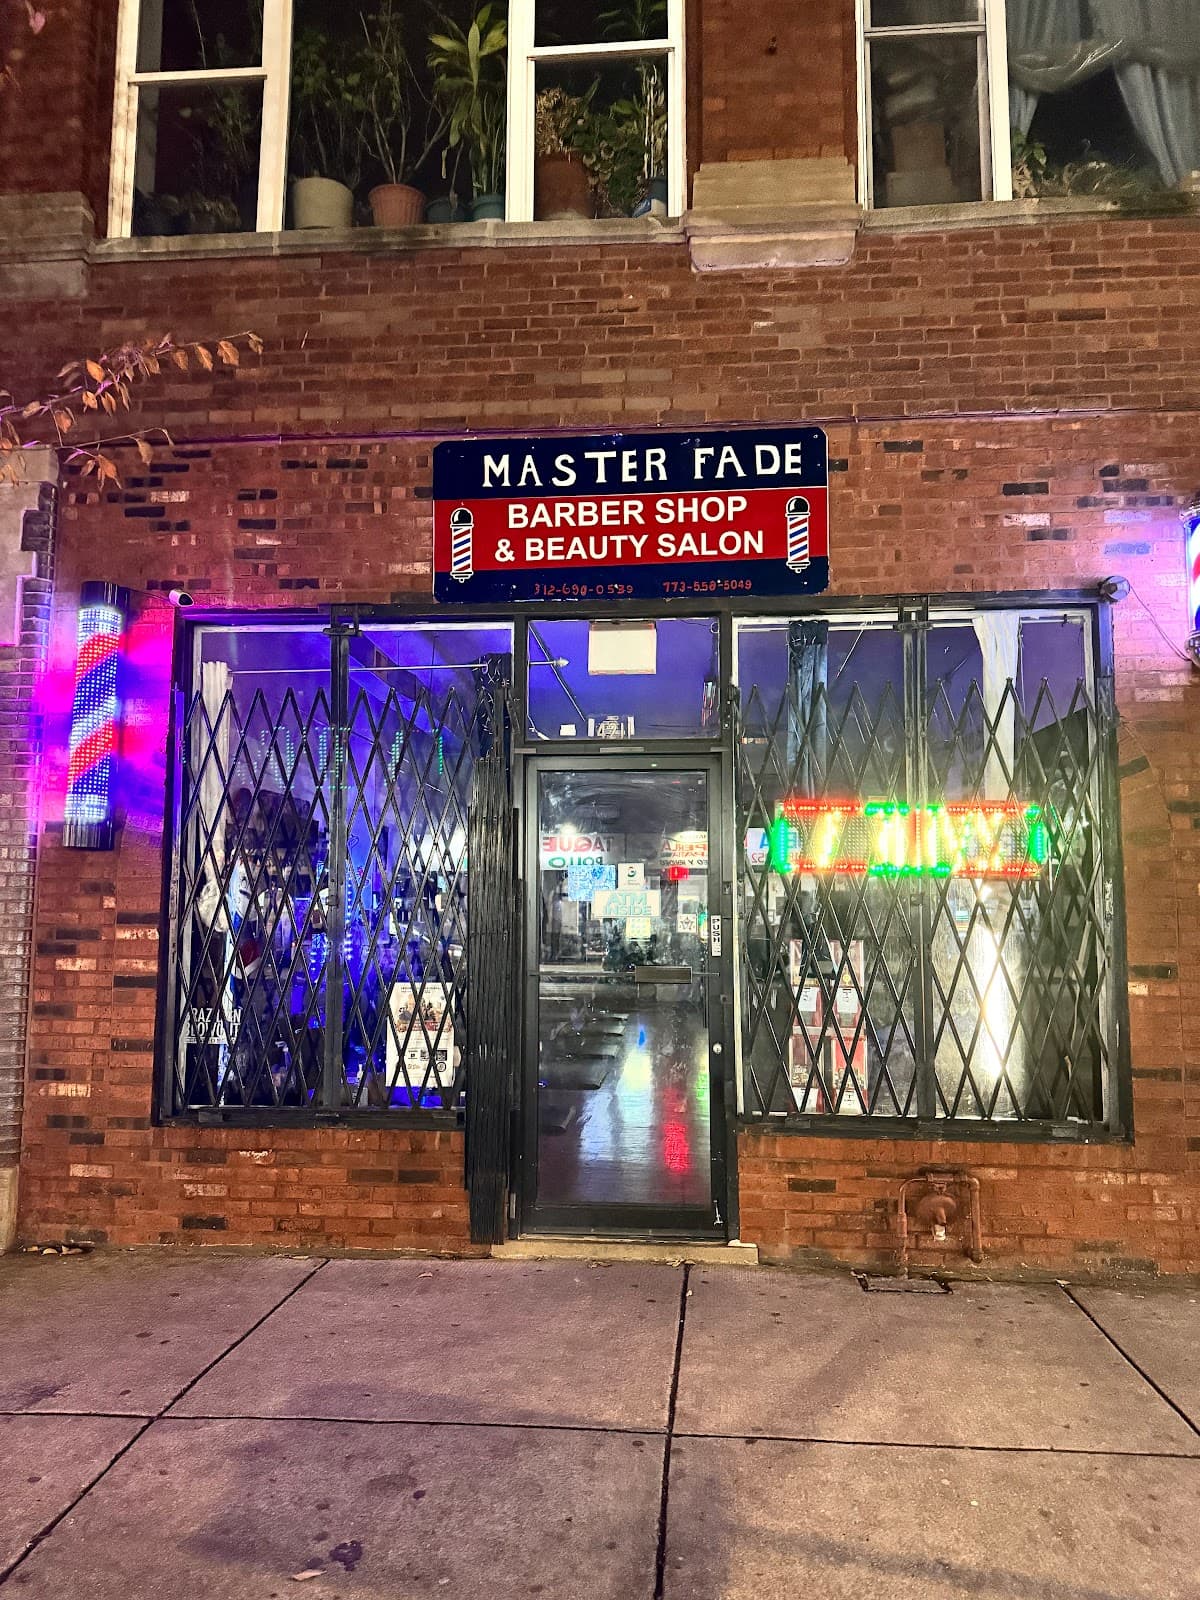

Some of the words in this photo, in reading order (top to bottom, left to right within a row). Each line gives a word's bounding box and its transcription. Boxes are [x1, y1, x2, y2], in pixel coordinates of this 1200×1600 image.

[482, 447, 667, 488] MASTER
[694, 443, 802, 480] FADE
[507, 500, 645, 529] BARBER
[655, 496, 747, 524] SHOP
[494, 540, 515, 562] &
[525, 534, 649, 561] BEAUTY
[657, 530, 764, 557] SALON
[604, 905, 652, 916] INSIDE
[608, 893, 648, 905] ATM
[711, 918, 721, 943] PUSH
